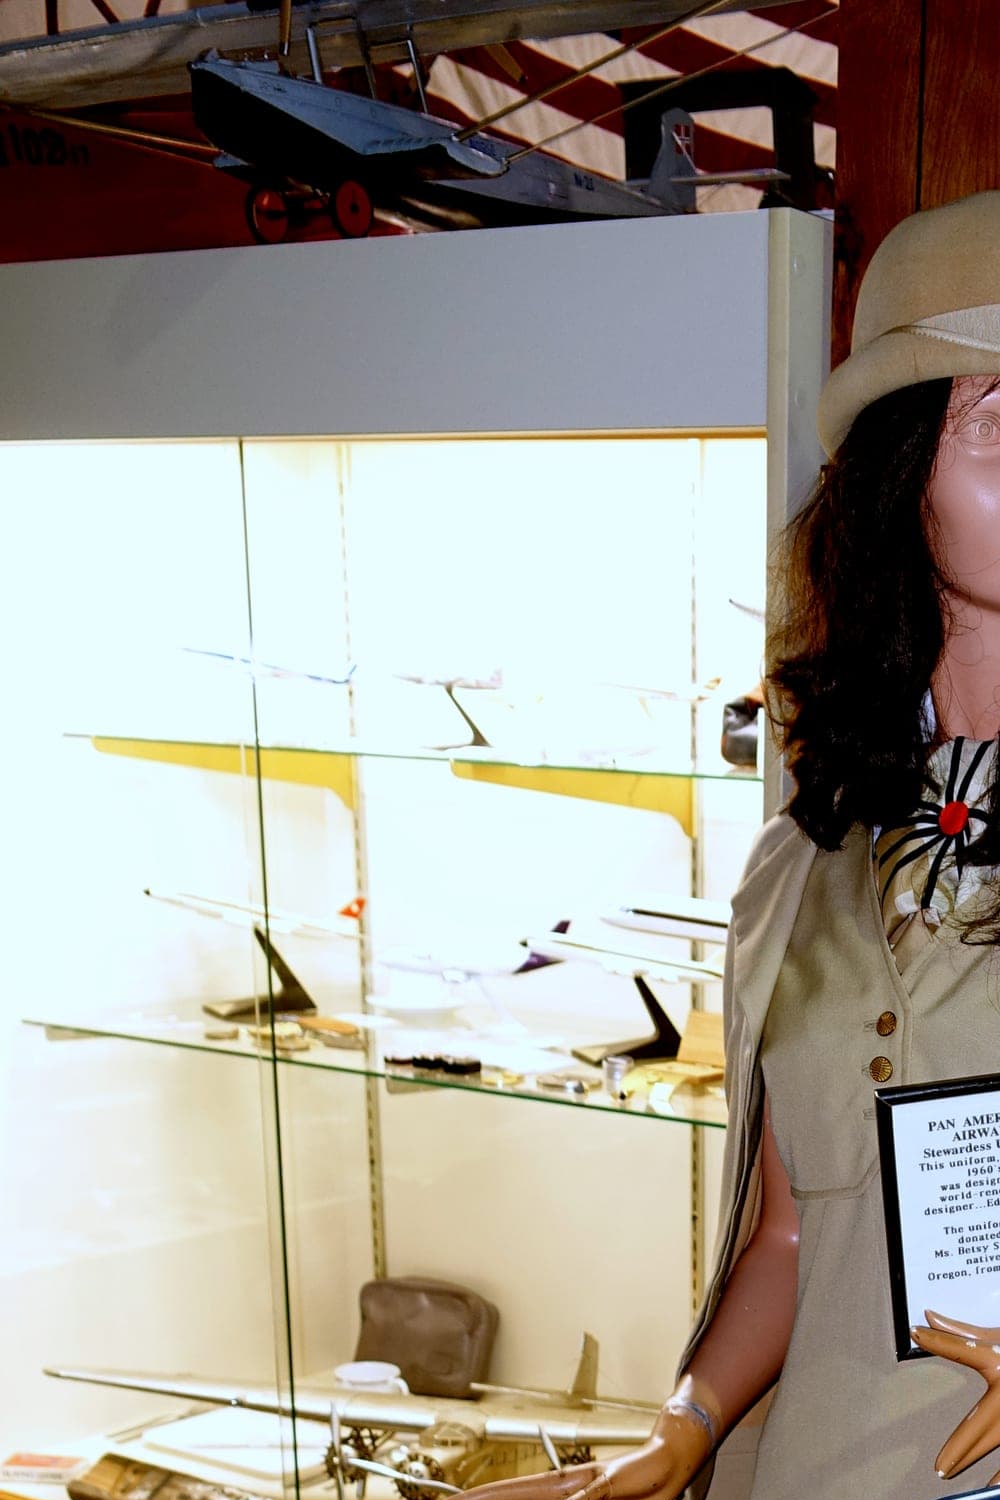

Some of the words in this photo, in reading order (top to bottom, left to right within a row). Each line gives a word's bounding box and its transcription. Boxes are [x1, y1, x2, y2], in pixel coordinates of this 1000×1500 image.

[928, 1119, 956, 1132] PAN
[923, 1141, 992, 1158] Stewardess
[919, 1161, 945, 1172] This
[940, 1181, 961, 1191] was
[944, 1225, 964, 1235] The
[935, 1249, 953, 1259] Ms.
[958, 1244, 989, 1257] Betsy
[966, 1254, 1000, 1266] native
[928, 1269, 972, 1283] Oregon,
[975, 1263, 1000, 1276] from
